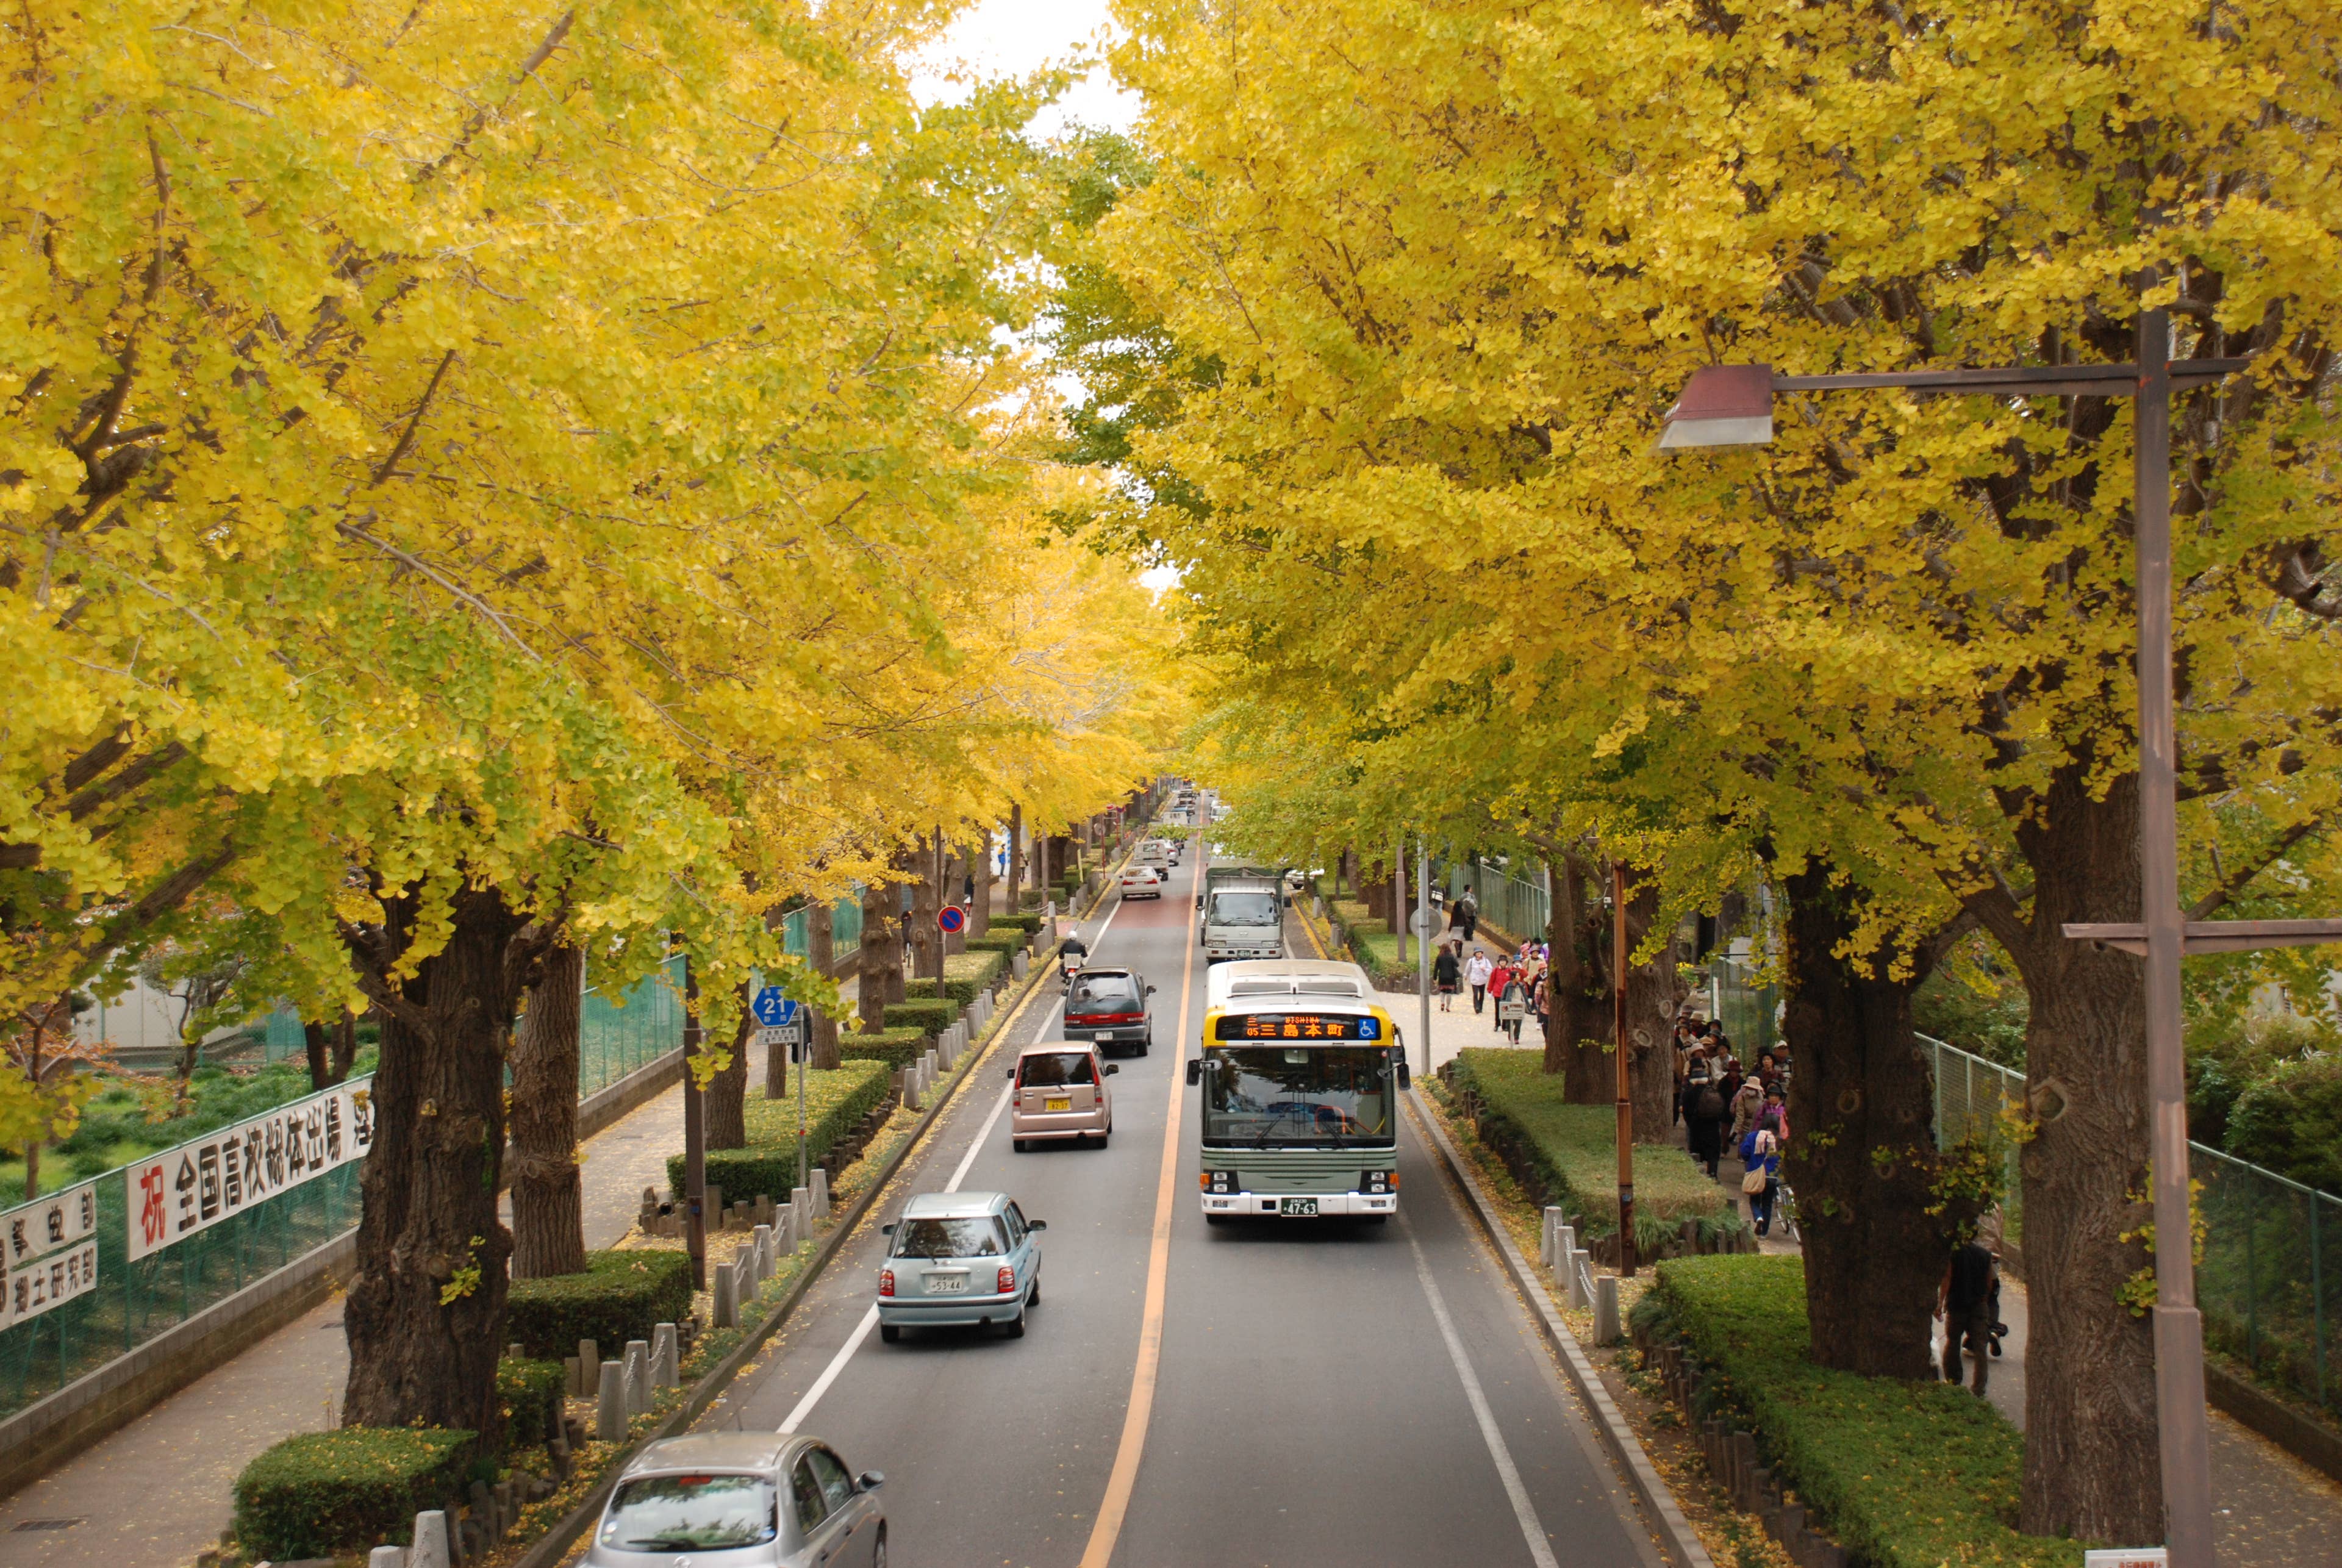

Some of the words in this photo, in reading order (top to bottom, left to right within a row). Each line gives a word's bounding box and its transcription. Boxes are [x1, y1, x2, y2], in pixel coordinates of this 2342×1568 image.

[764, 998, 785, 1014] 21
[1260, 1024, 1344, 1037] 三島本町
[141, 1164, 166, 1247] 祝
[1288, 1203, 1316, 1214] 47-63
